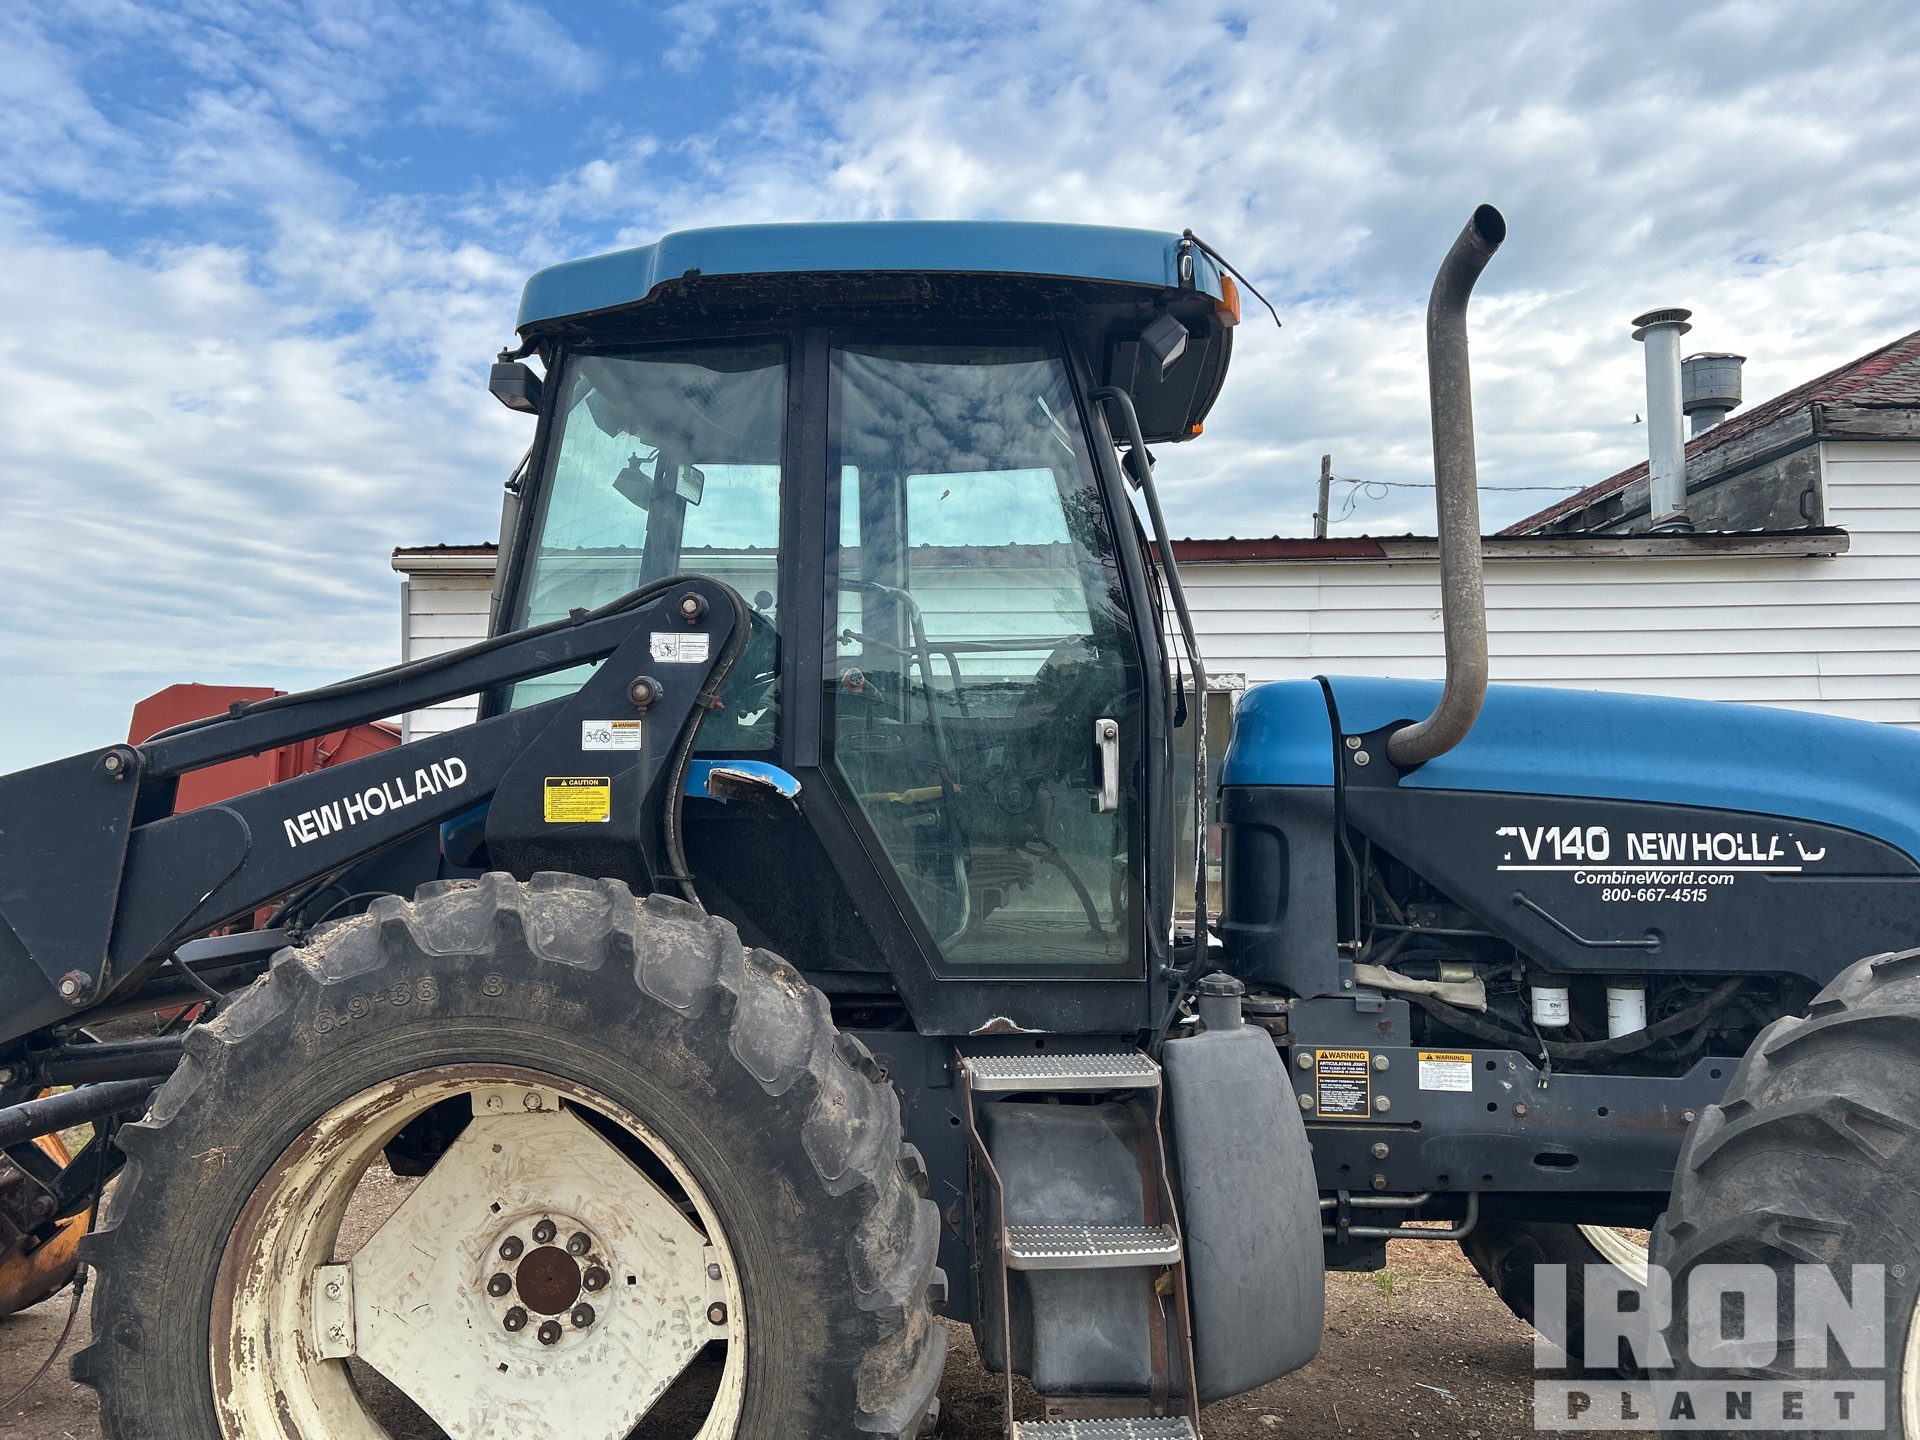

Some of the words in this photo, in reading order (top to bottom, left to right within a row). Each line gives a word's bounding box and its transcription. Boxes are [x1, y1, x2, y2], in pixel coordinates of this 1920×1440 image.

[283, 801, 343, 848] NEW
[343, 757, 468, 826] HOLLAND
[1628, 832, 1687, 861] NEW
[1574, 871, 1735, 885] CombineWorld.com
[1601, 888, 1707, 903] 800-667-4515
[294, 976, 438, 1045] 16.9-38
[481, 973, 504, 997] 8
[1328, 1051, 1366, 1060] WARNING
